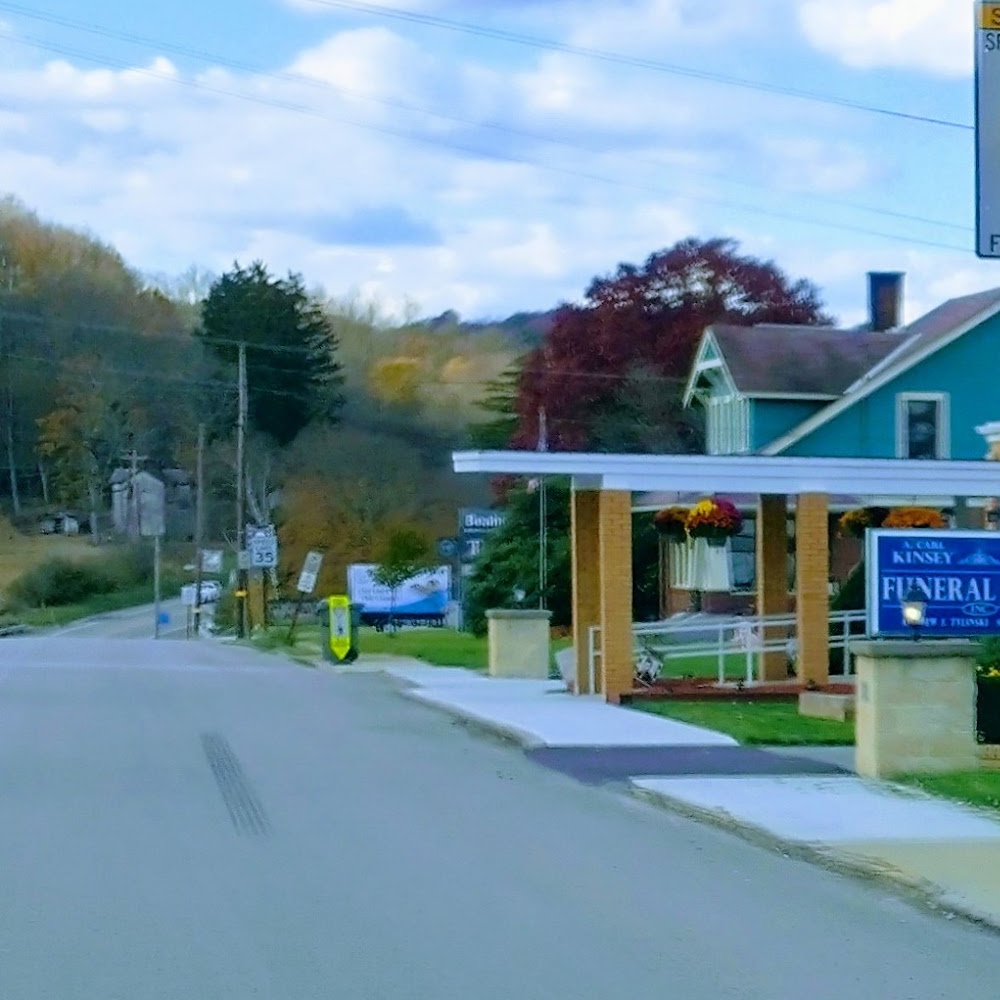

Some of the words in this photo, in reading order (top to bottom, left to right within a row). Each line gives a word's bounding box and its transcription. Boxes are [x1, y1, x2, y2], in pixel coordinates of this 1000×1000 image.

[255, 552, 274, 563] 35
[893, 551, 953, 564] KINSEY
[882, 577, 997, 601] FUNERAL
